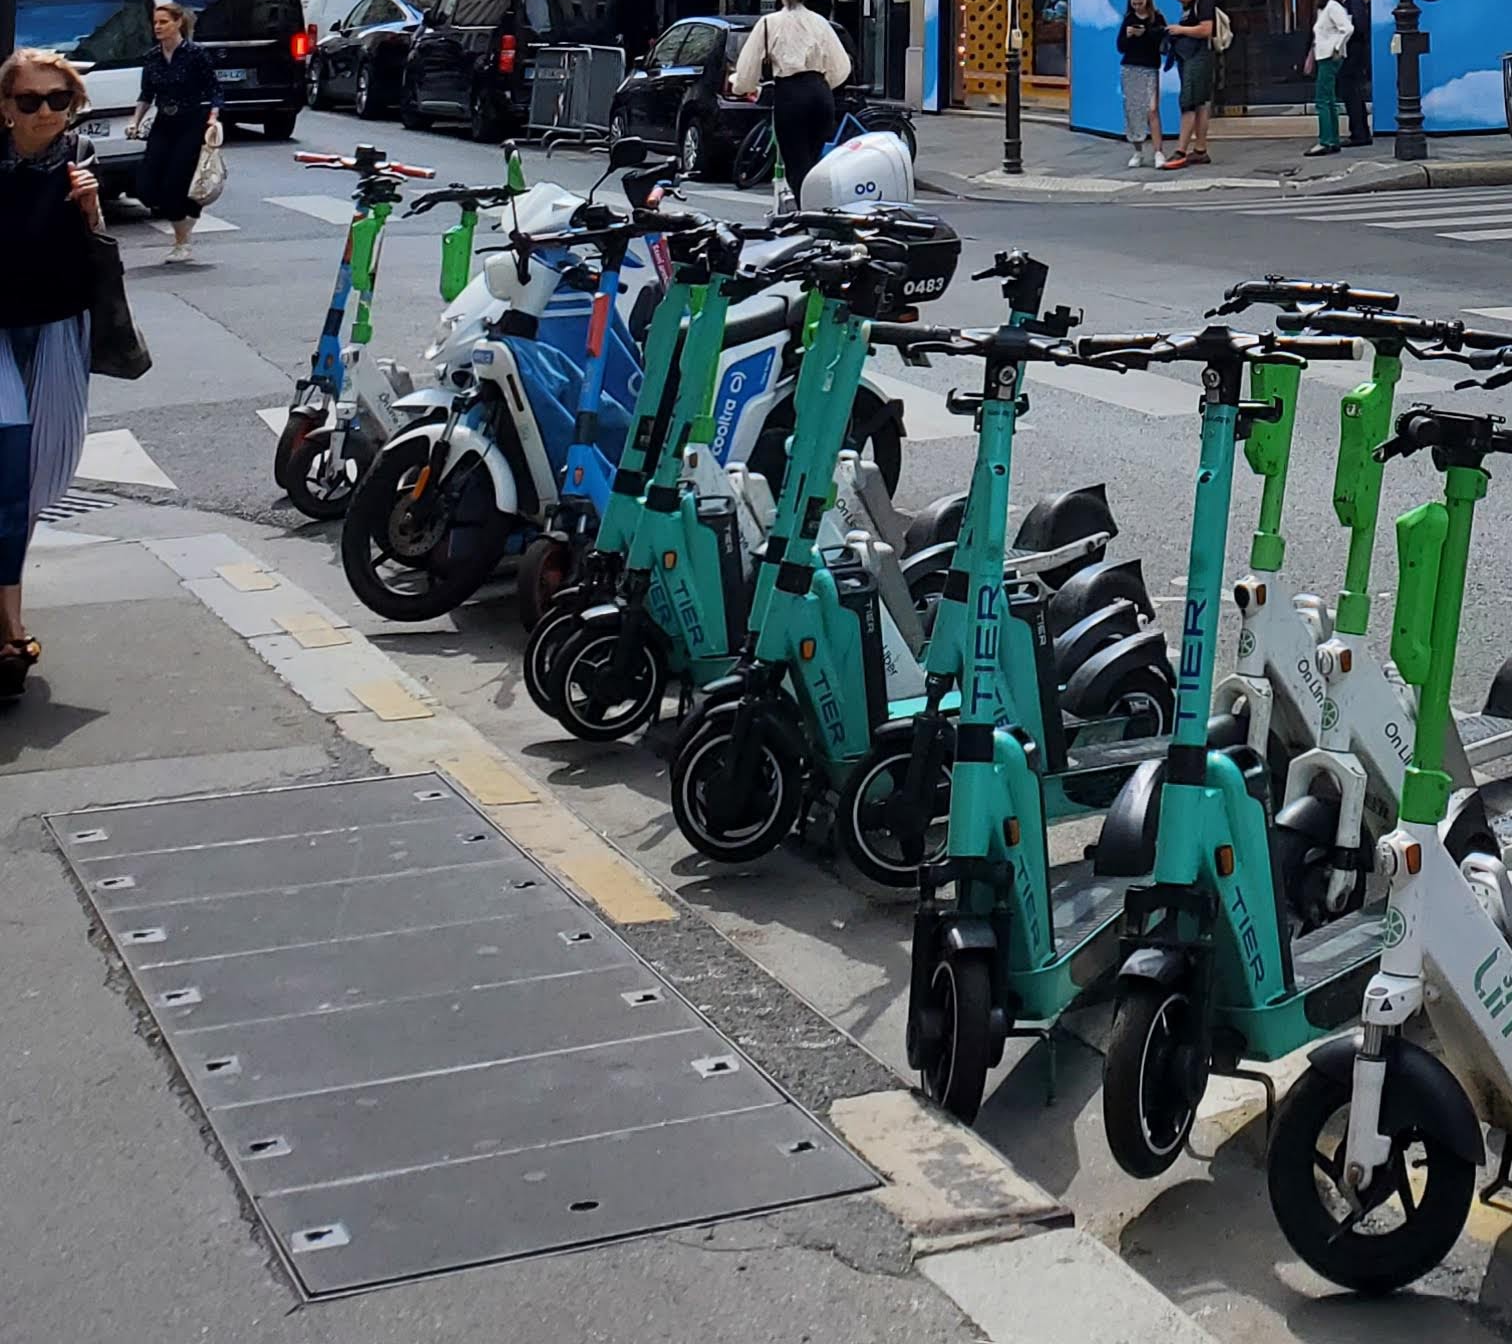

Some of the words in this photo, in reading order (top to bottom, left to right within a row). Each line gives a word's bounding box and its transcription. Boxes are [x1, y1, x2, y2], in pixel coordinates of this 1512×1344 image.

[903, 276, 945, 295] 0483
[712, 398, 738, 456] cooltra
[675, 578, 704, 647] TIER
[863, 597, 876, 634] TIER
[1036, 610, 1047, 647] TIER
[971, 584, 1000, 715] TIER
[1174, 598, 1208, 737] TIER
[1298, 660, 1313, 683] On
[813, 669, 847, 745] TIER
[1385, 722, 1402, 749] On
[1018, 854, 1040, 951] TIER
[1232, 884, 1265, 989] TIER
